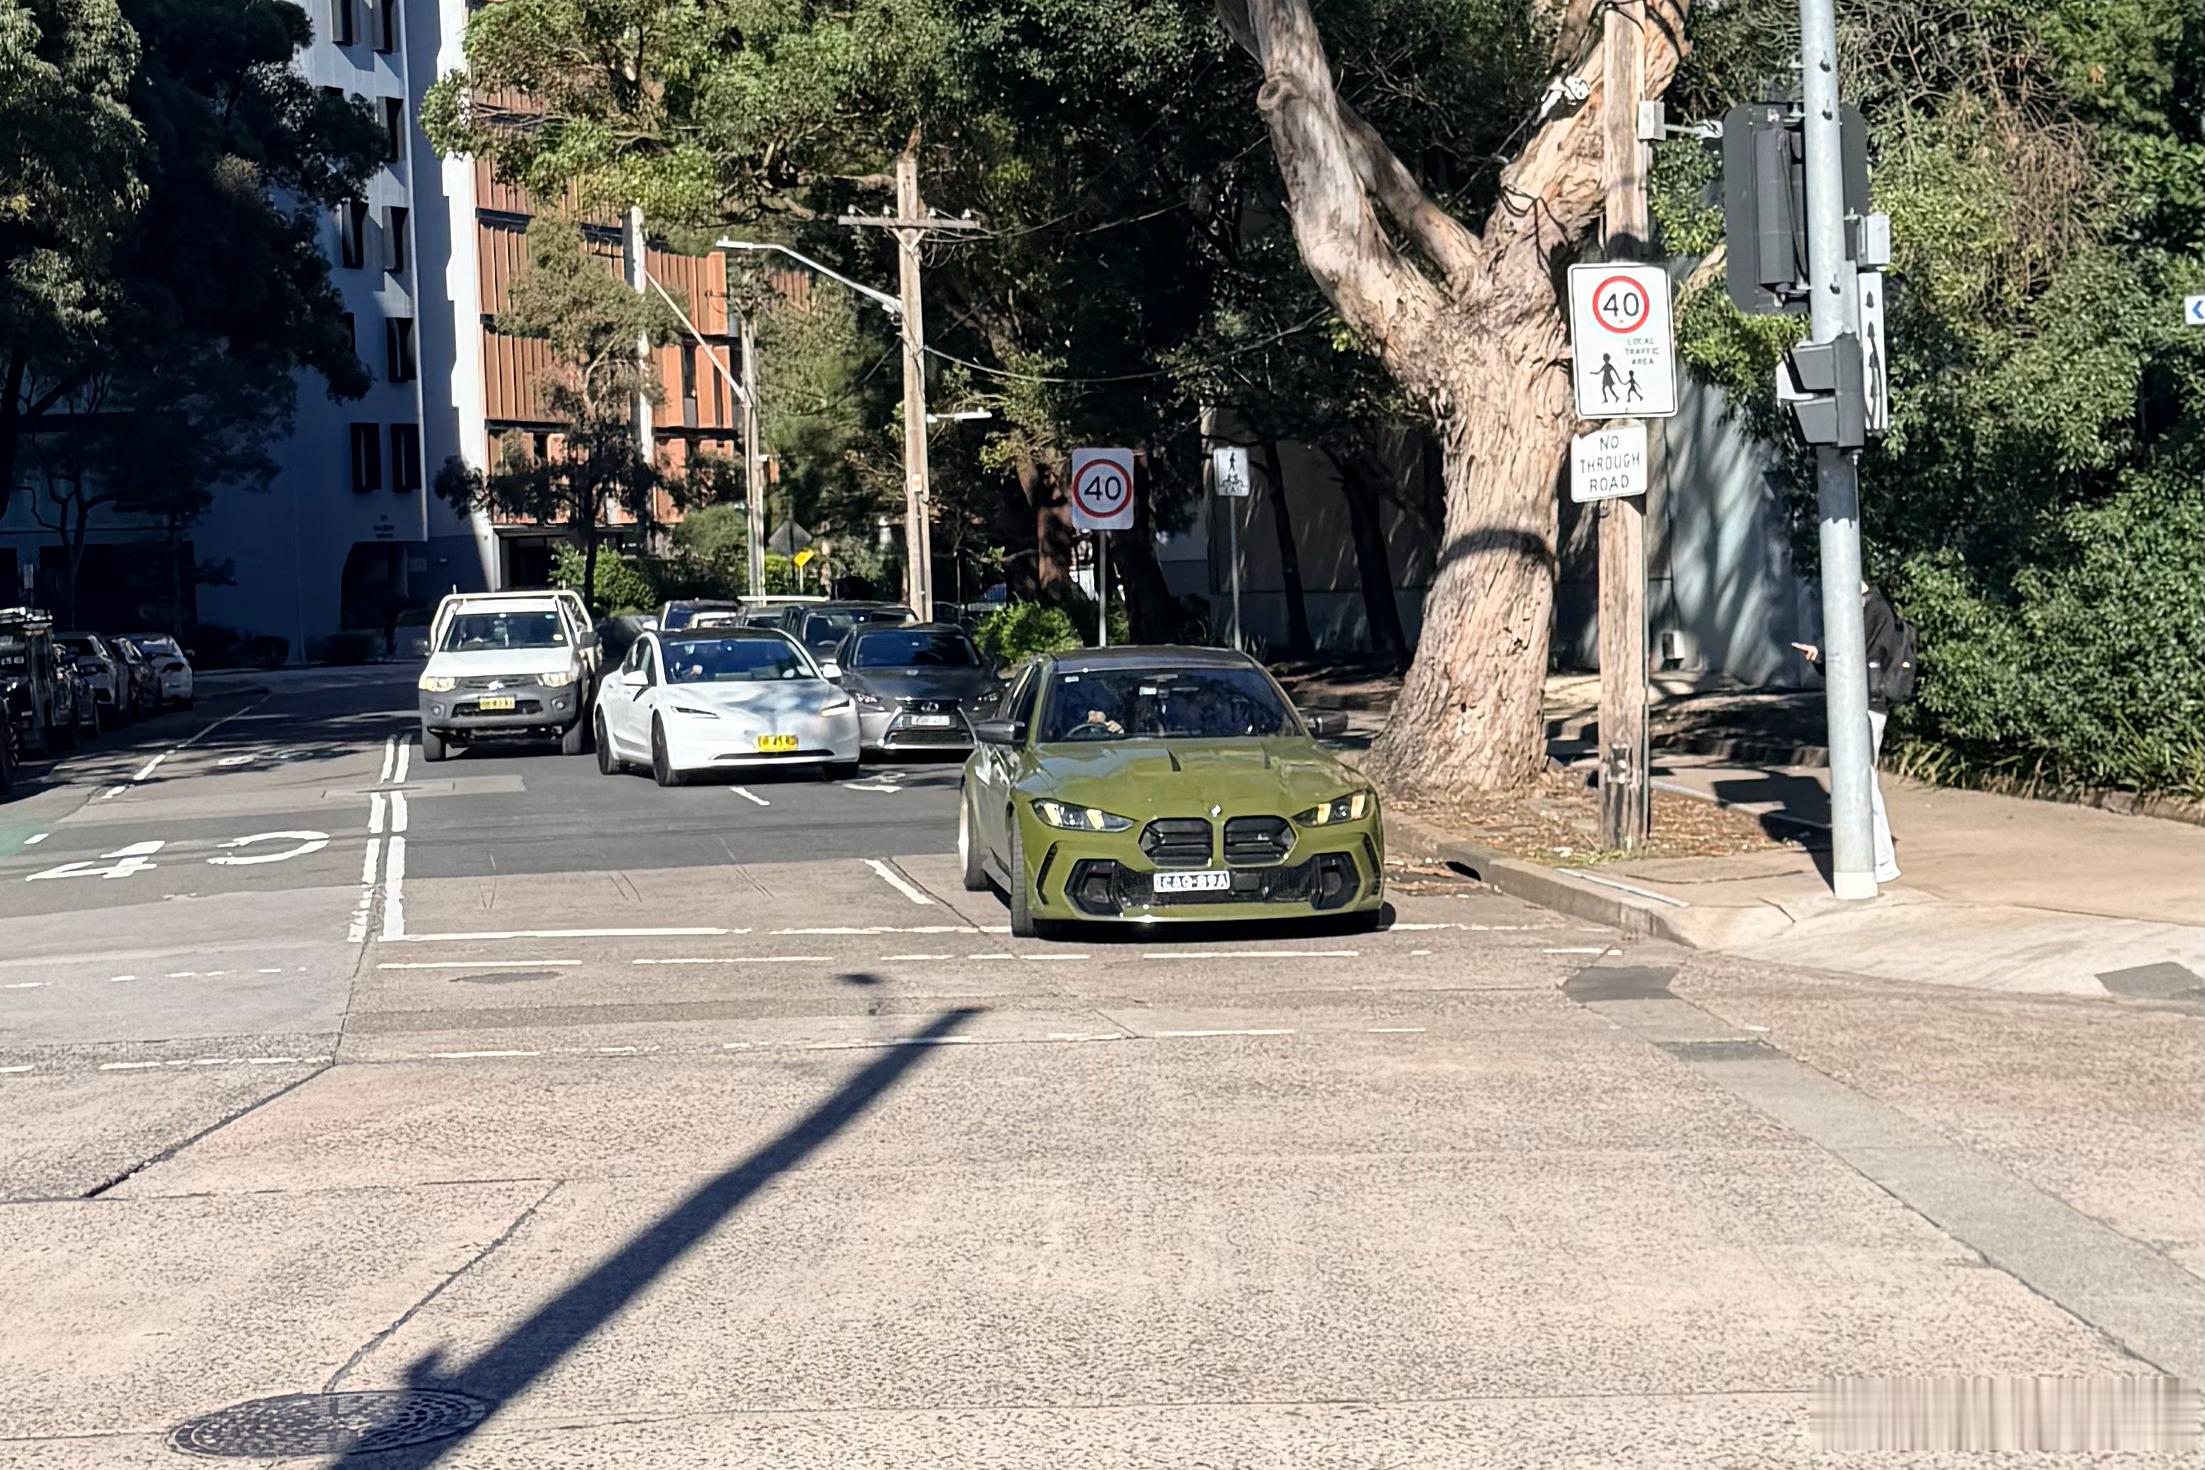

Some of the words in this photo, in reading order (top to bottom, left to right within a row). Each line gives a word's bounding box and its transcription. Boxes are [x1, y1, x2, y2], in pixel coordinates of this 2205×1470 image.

[1603, 292, 1640, 317] 40
[1626, 337, 1655, 346] LOCAL
[1631, 357, 1655, 366] AREA
[1600, 435, 1620, 451] NO
[1580, 452, 1641, 475] THROUGH
[1083, 475, 1122, 501] 40
[1589, 474, 1630, 493] ROAD
